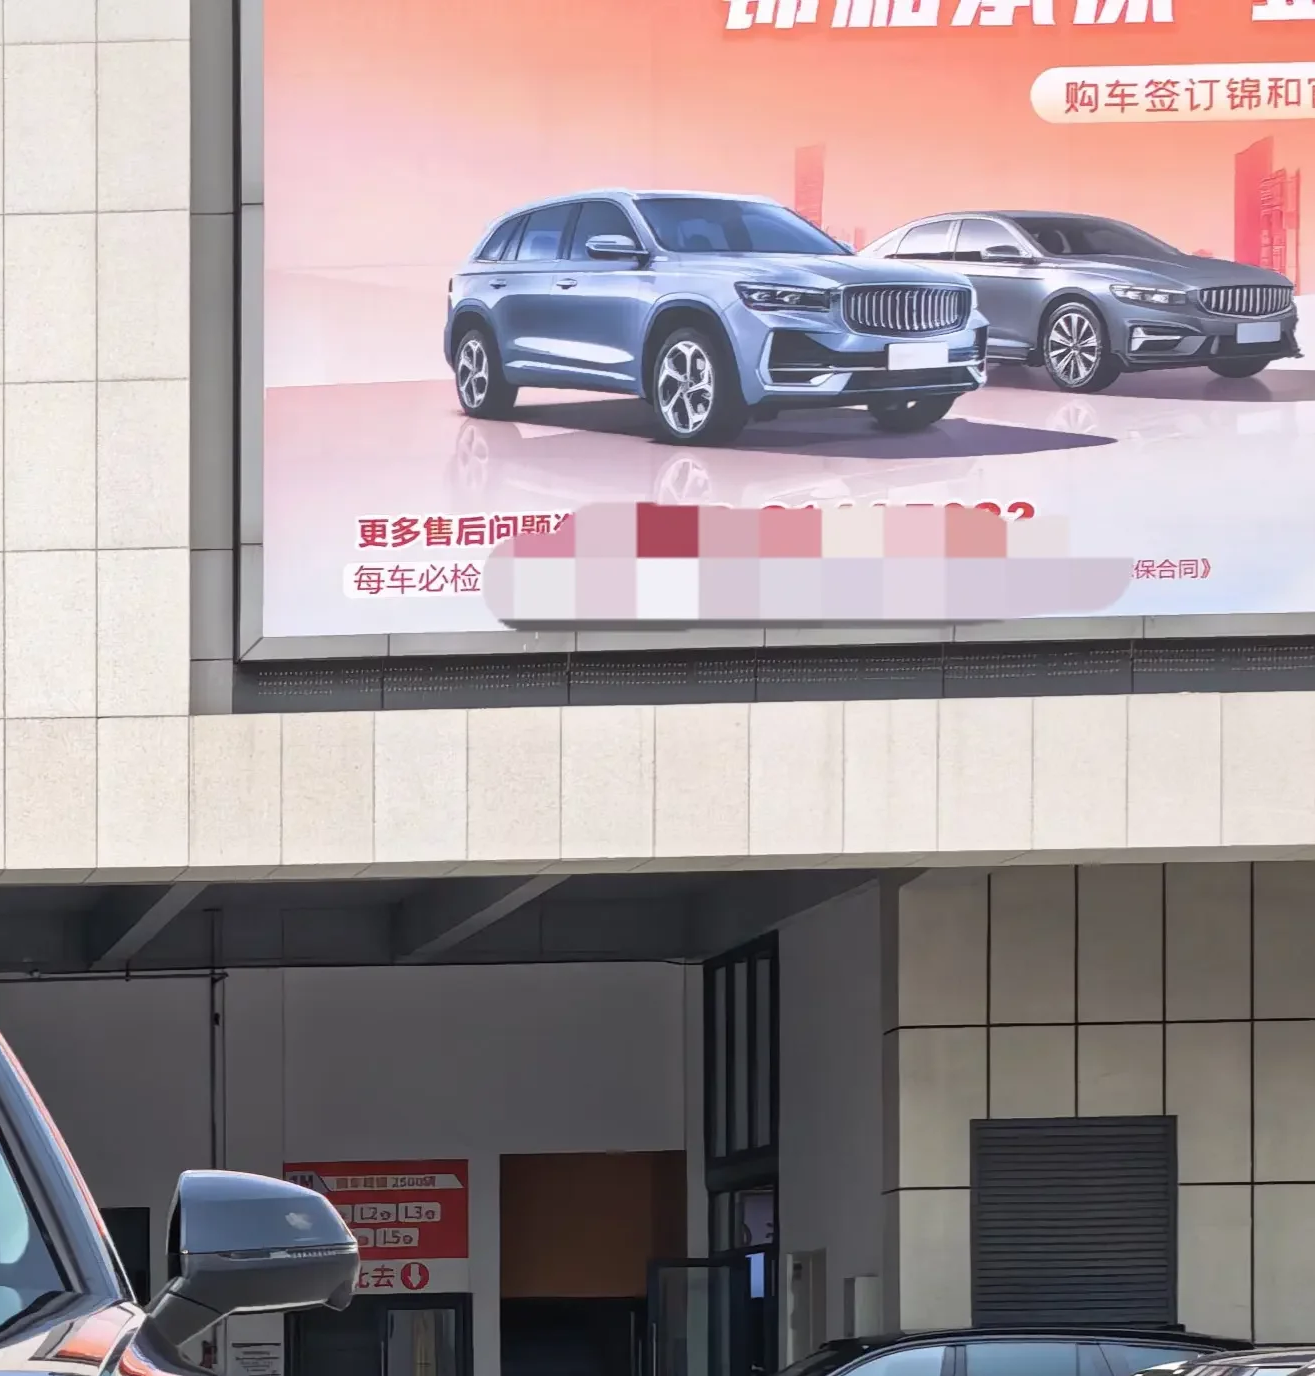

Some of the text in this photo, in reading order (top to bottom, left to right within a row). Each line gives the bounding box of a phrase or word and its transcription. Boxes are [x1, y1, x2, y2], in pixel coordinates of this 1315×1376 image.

[358, 512, 573, 548] 更多售后问题
[353, 563, 482, 595] 每车必检
[1132, 557, 1212, 580] 保合同》
